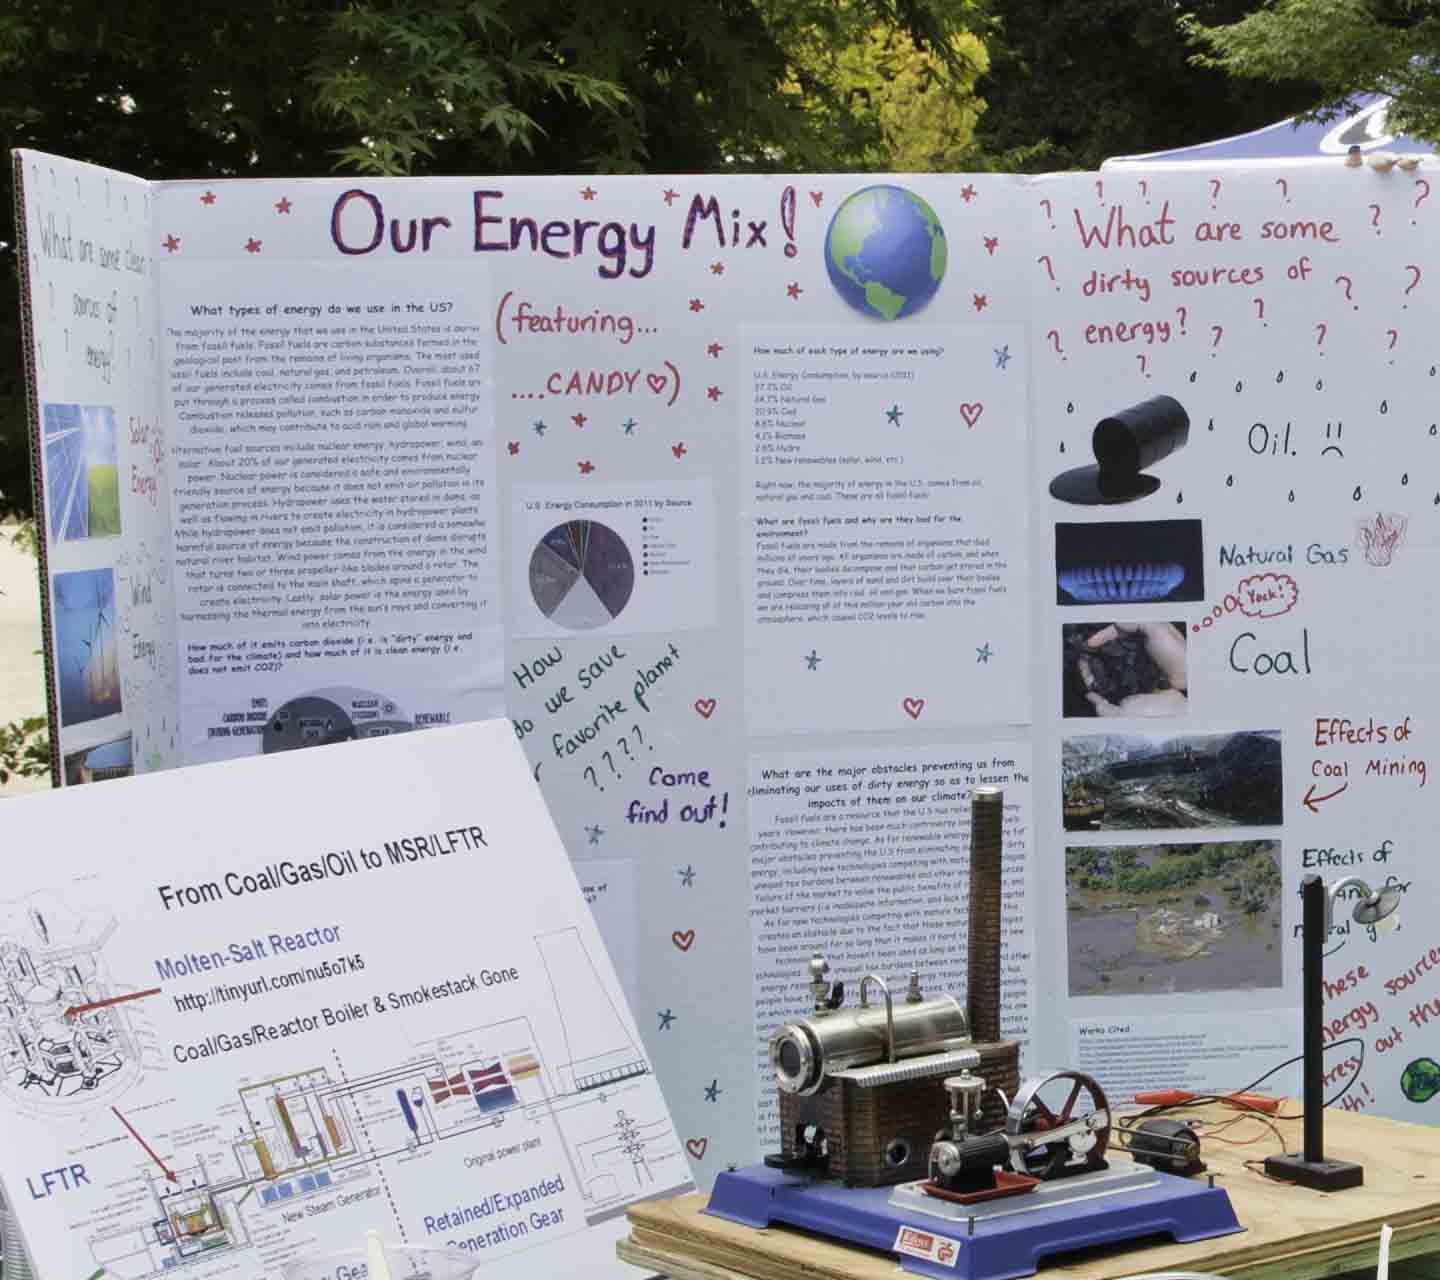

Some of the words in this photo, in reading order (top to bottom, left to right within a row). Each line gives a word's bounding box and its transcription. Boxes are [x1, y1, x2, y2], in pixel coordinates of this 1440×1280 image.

[39, 205, 73, 262] What
[331, 188, 451, 255] Our
[472, 190, 656, 279] Energy
[682, 185, 797, 258] Mix!
[1074, 201, 1175, 249] What
[1195, 220, 1241, 242] are
[1261, 219, 1340, 242] some
[1083, 270, 1150, 301] dirty
[1171, 265, 1264, 287] sources
[1288, 257, 1312, 280] of
[190, 305, 222, 316] What
[230, 306, 260, 318] types
[265, 304, 278, 314] of
[283, 305, 322, 317] energy
[328, 303, 341, 314] do
[346, 305, 361, 314] we
[366, 304, 384, 313] use
[391, 303, 400, 313] in
[406, 302, 424, 313] the
[430, 302, 453, 312] US?
[1085, 307, 1187, 344] energy?
[1219, 544, 1293, 568] Natural
[1307, 544, 1349, 566] Gas
[210, 641, 234, 651] much
[289, 638, 320, 648] carbon
[323, 637, 354, 647] dioxide
[425, 634, 455, 645] energy
[324, 647, 347, 657] much
[385, 644, 408, 654] clean
[410, 644, 440, 656] energy
[1230, 628, 1311, 675] Coal
[231, 664, 250, 673] emit
[513, 645, 562, 689] How
[513, 719, 534, 740] do
[545, 685, 575, 714] we
[578, 645, 627, 689] save
[553, 700, 628, 758] favorite
[634, 643, 680, 713] planet
[1315, 719, 1387, 746] Effects
[1394, 717, 1412, 743] of
[649, 767, 711, 787] Come
[762, 769, 790, 780] What
[794, 770, 812, 778] are
[817, 767, 833, 778] the
[838, 766, 866, 780] major
[872, 763, 918, 775] obstacles
[922, 760, 973, 773] preventing
[977, 761, 988, 769] us
[992, 757, 1015, 768] from
[805, 784, 822, 793] our
[825, 783, 848, 793] uses
[852, 781, 862, 791] of
[868, 779, 893, 792] dirty
[897, 779, 930, 791] energy
[934, 777, 945, 786] so
[949, 777, 960, 785] as
[965, 775, 976, 785] to
[980, 773, 1008, 784] lessen
[1013, 772, 1029, 783] the
[1312, 759, 1348, 778] Coal
[1365, 755, 1426, 788] Mining
[625, 798, 668, 823] find
[679, 792, 728, 829] out!
[808, 798, 846, 810] impacts
[851, 797, 862, 807] of
[867, 795, 890, 805] them
[896, 795, 907, 804] on
[911, 794, 928, 803] our
[158, 879, 223, 911] From
[225, 851, 358, 897] Coal/Gas/Oil
[360, 848, 383, 870] to
[383, 825, 489, 865] MSR/LFTR
[1302, 848, 1363, 869] Effects
[1373, 840, 1393, 862] of
[155, 939, 267, 981] Molten-Salt
[269, 924, 341, 956] Reactor
[1321, 963, 1370, 1001] hese
[173, 1017, 320, 1063] Coal/Gas/Reactor
[321, 1001, 370, 1028] Boiler
[373, 995, 386, 1014] &
[388, 974, 479, 1011] Smokestack
[479, 966, 520, 991] Gone
[1079, 1025, 1105, 1036] Works
[1321, 1000, 1380, 1043] nergy
[1375, 1026, 1403, 1053] out
[463, 1149, 496, 1169] Original
[496, 1144, 522, 1163] power
[521, 1136, 542, 1156] plant
[25, 1163, 91, 1201] LFTR
[281, 1207, 304, 1224] New
[310, 1198, 336, 1219] Steam
[337, 1184, 382, 1208] Generator
[424, 1174, 565, 1235] Retained/Expanded
[529, 1206, 565, 1230] Gear
